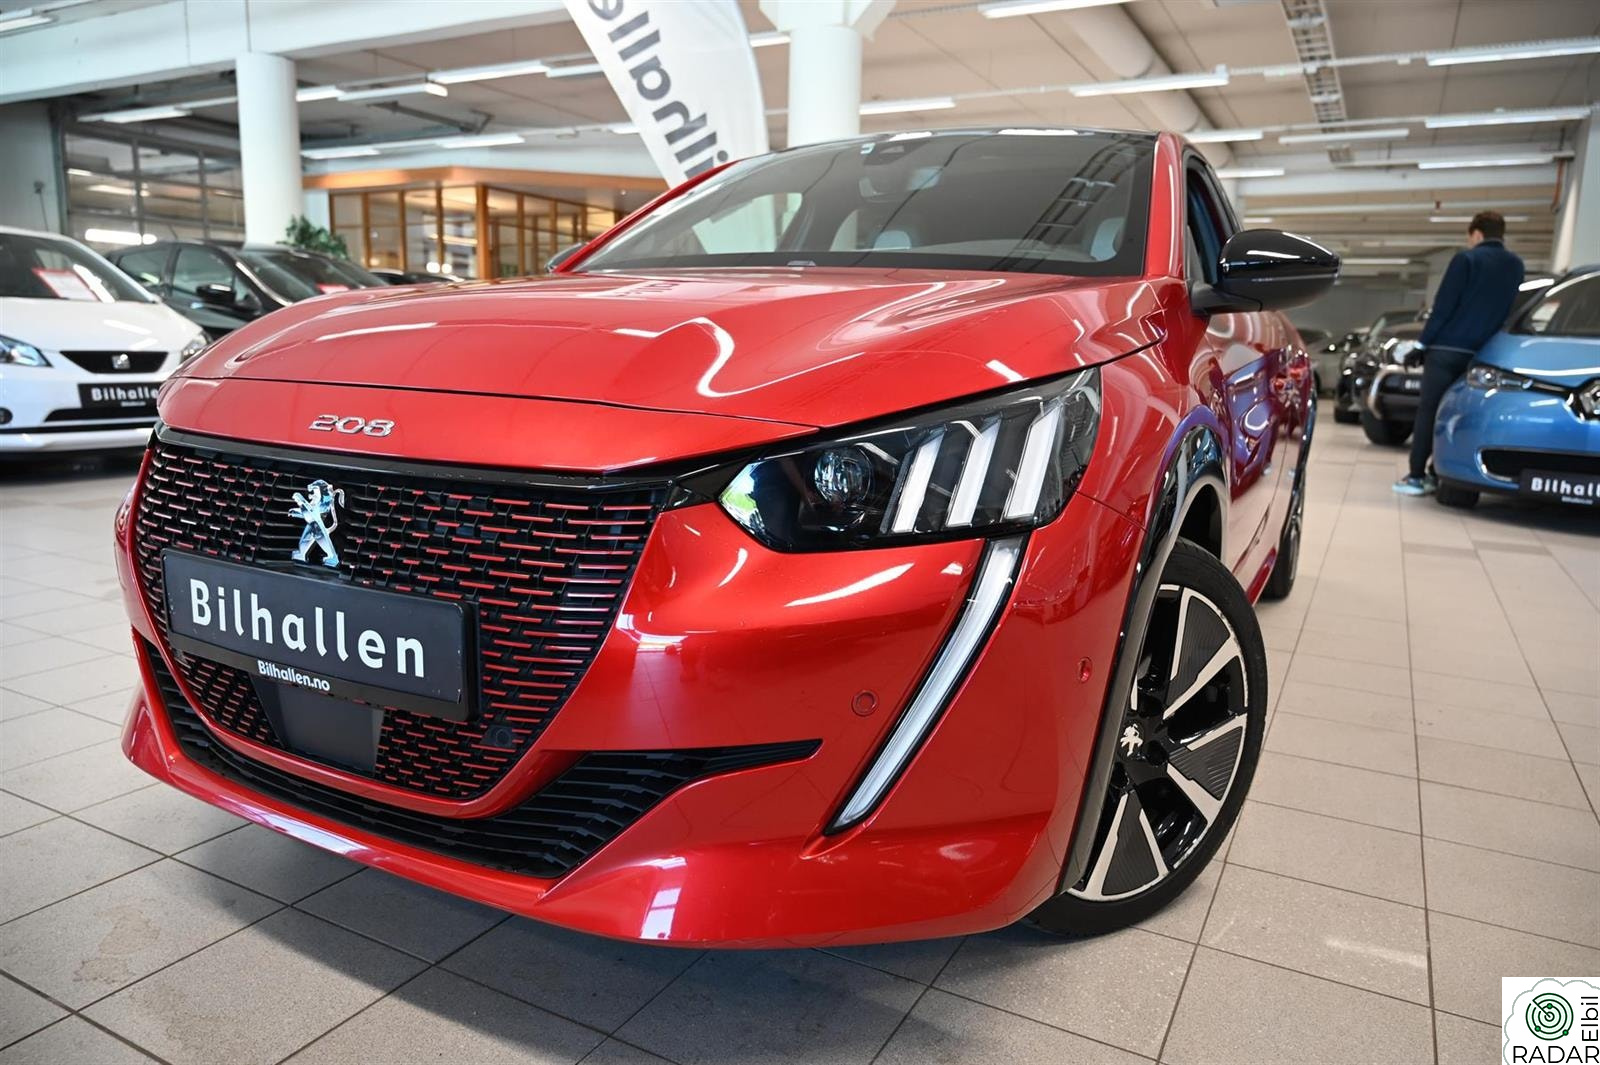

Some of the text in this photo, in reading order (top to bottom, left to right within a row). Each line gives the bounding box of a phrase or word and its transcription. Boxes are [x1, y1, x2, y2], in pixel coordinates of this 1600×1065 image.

[308, 414, 396, 437] 208
[189, 578, 425, 679] Bilhallen
[257, 659, 331, 692] Bilhallen.no
